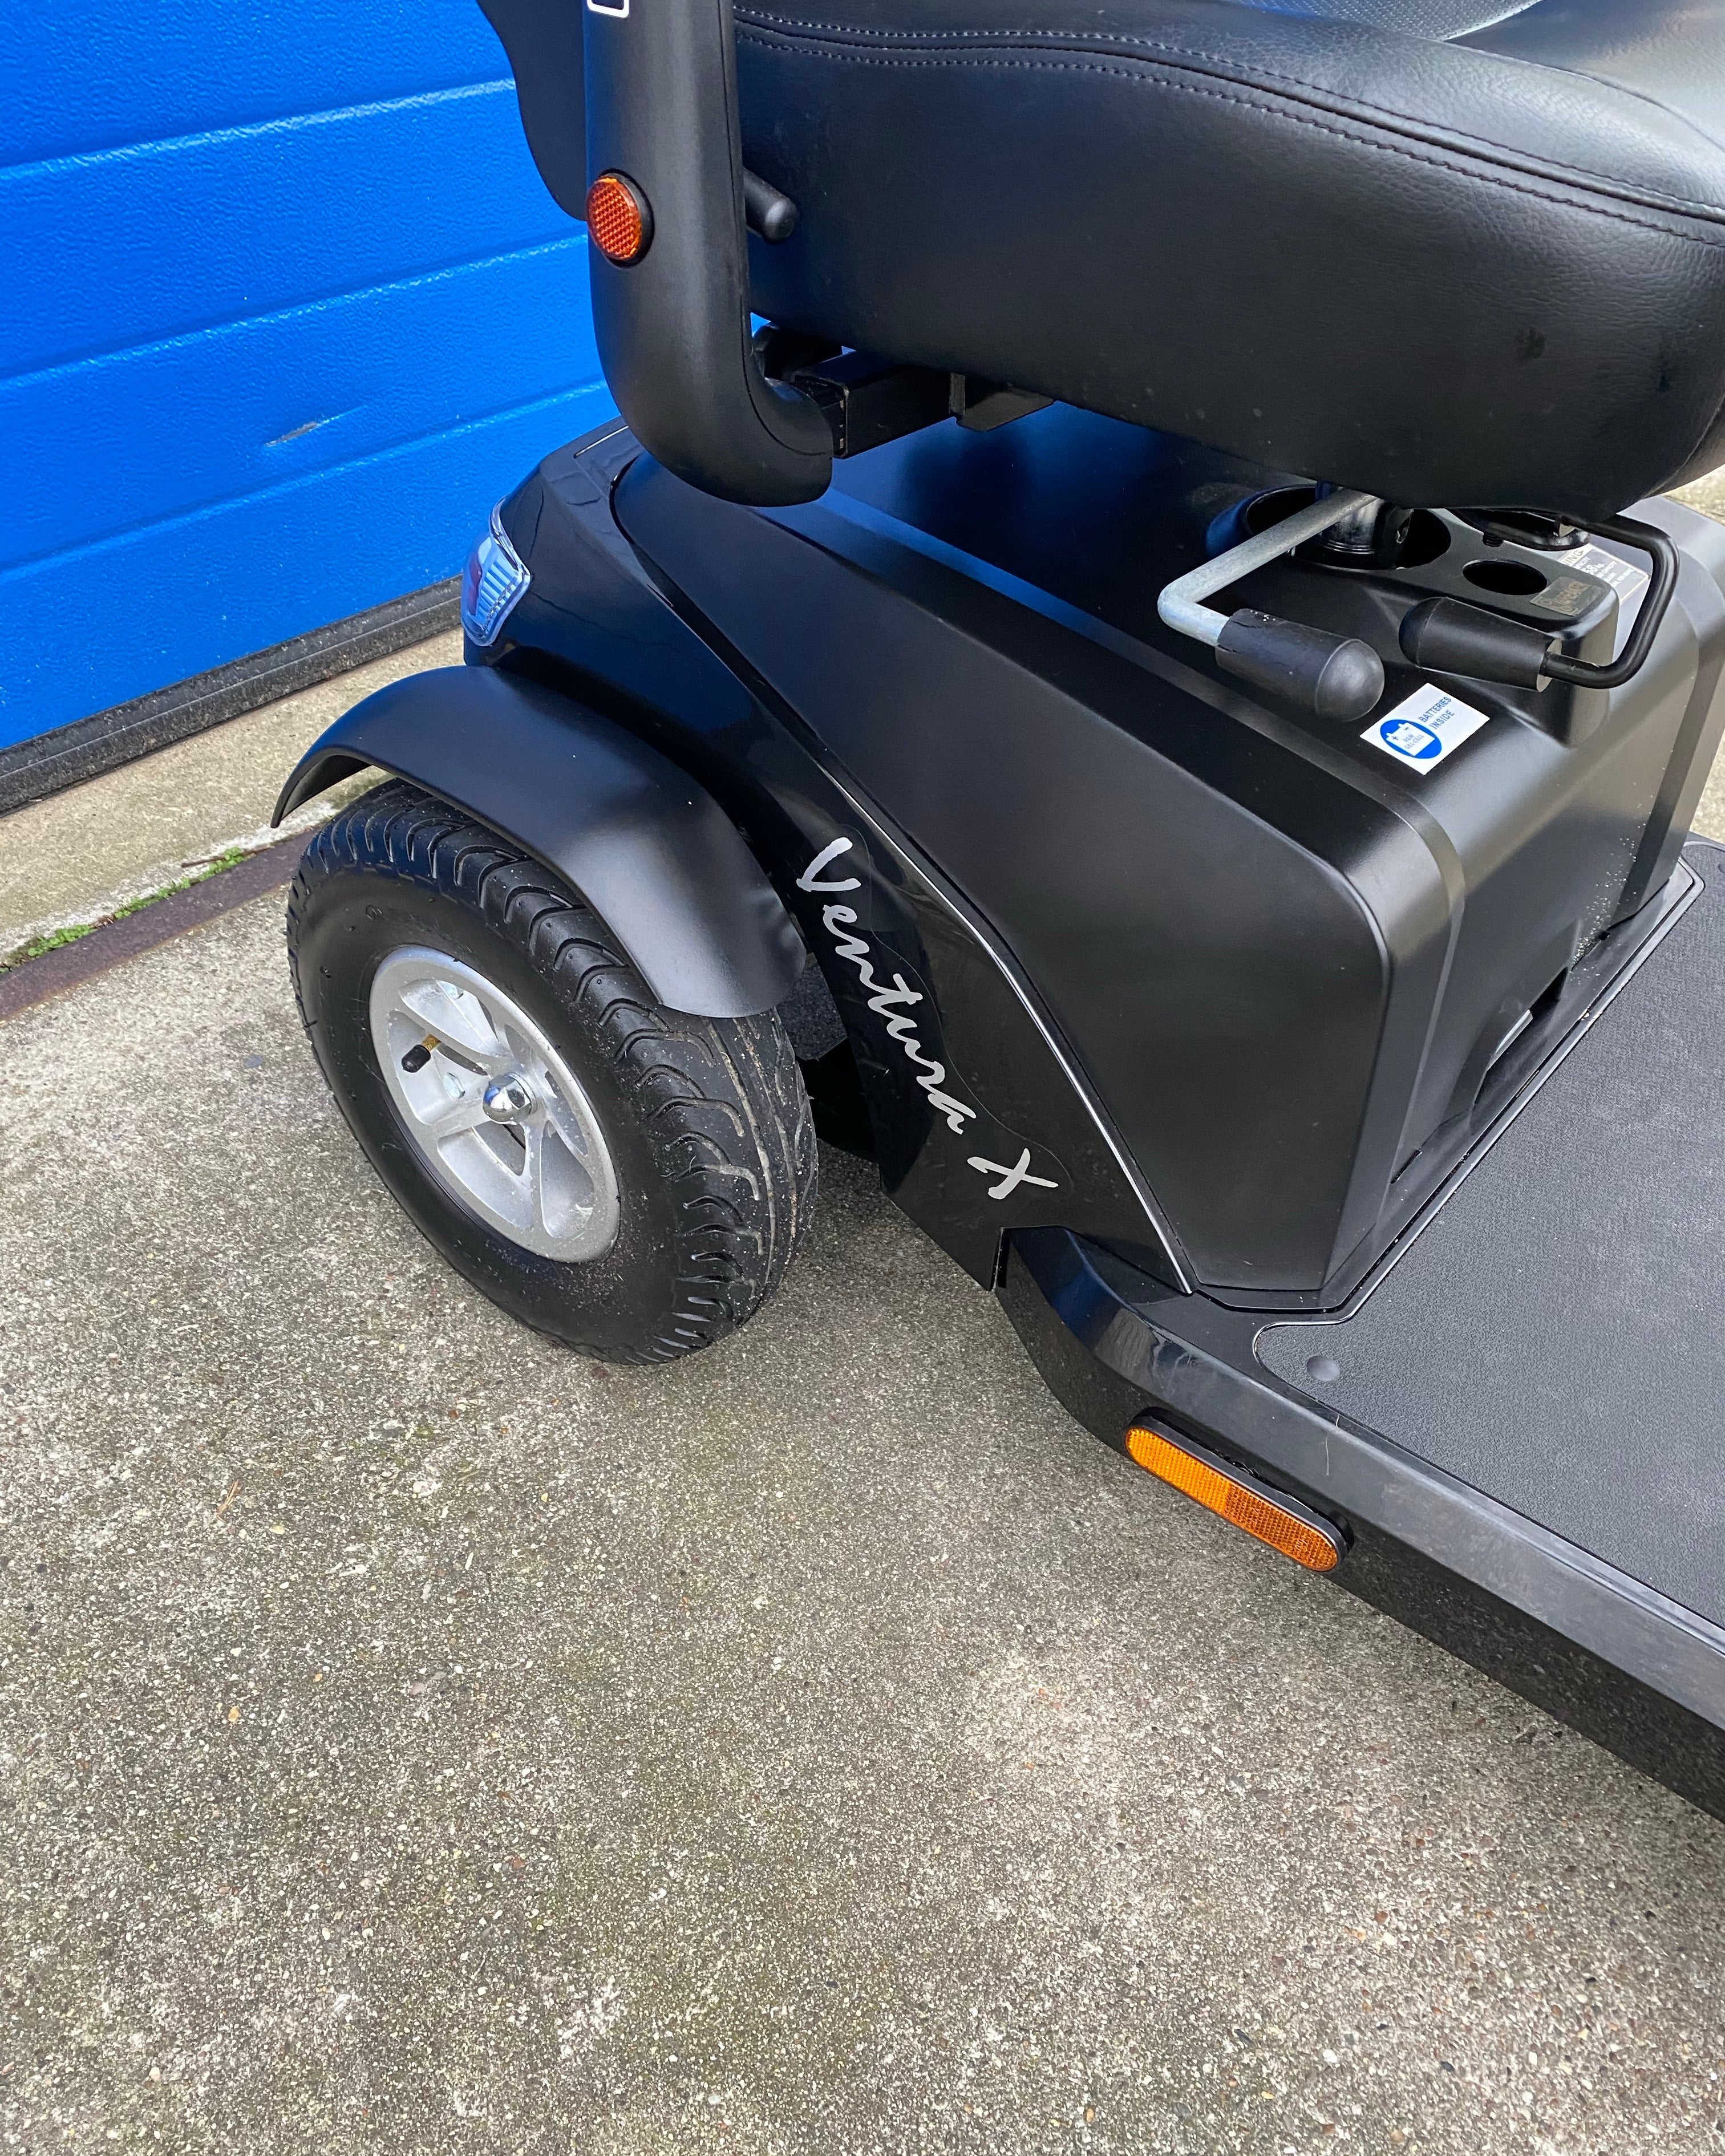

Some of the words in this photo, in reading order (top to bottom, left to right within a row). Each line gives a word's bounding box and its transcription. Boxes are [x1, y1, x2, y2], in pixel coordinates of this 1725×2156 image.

[1419, 696, 1452, 723] BATTERIES
[1429, 710, 1455, 730] INSIDE
[1403, 733, 1414, 743] AGM
[1404, 734, 1424, 749] GEL-CELL
[796, 837, 977, 1135] Ventura
[967, 1148, 1059, 1200] X
